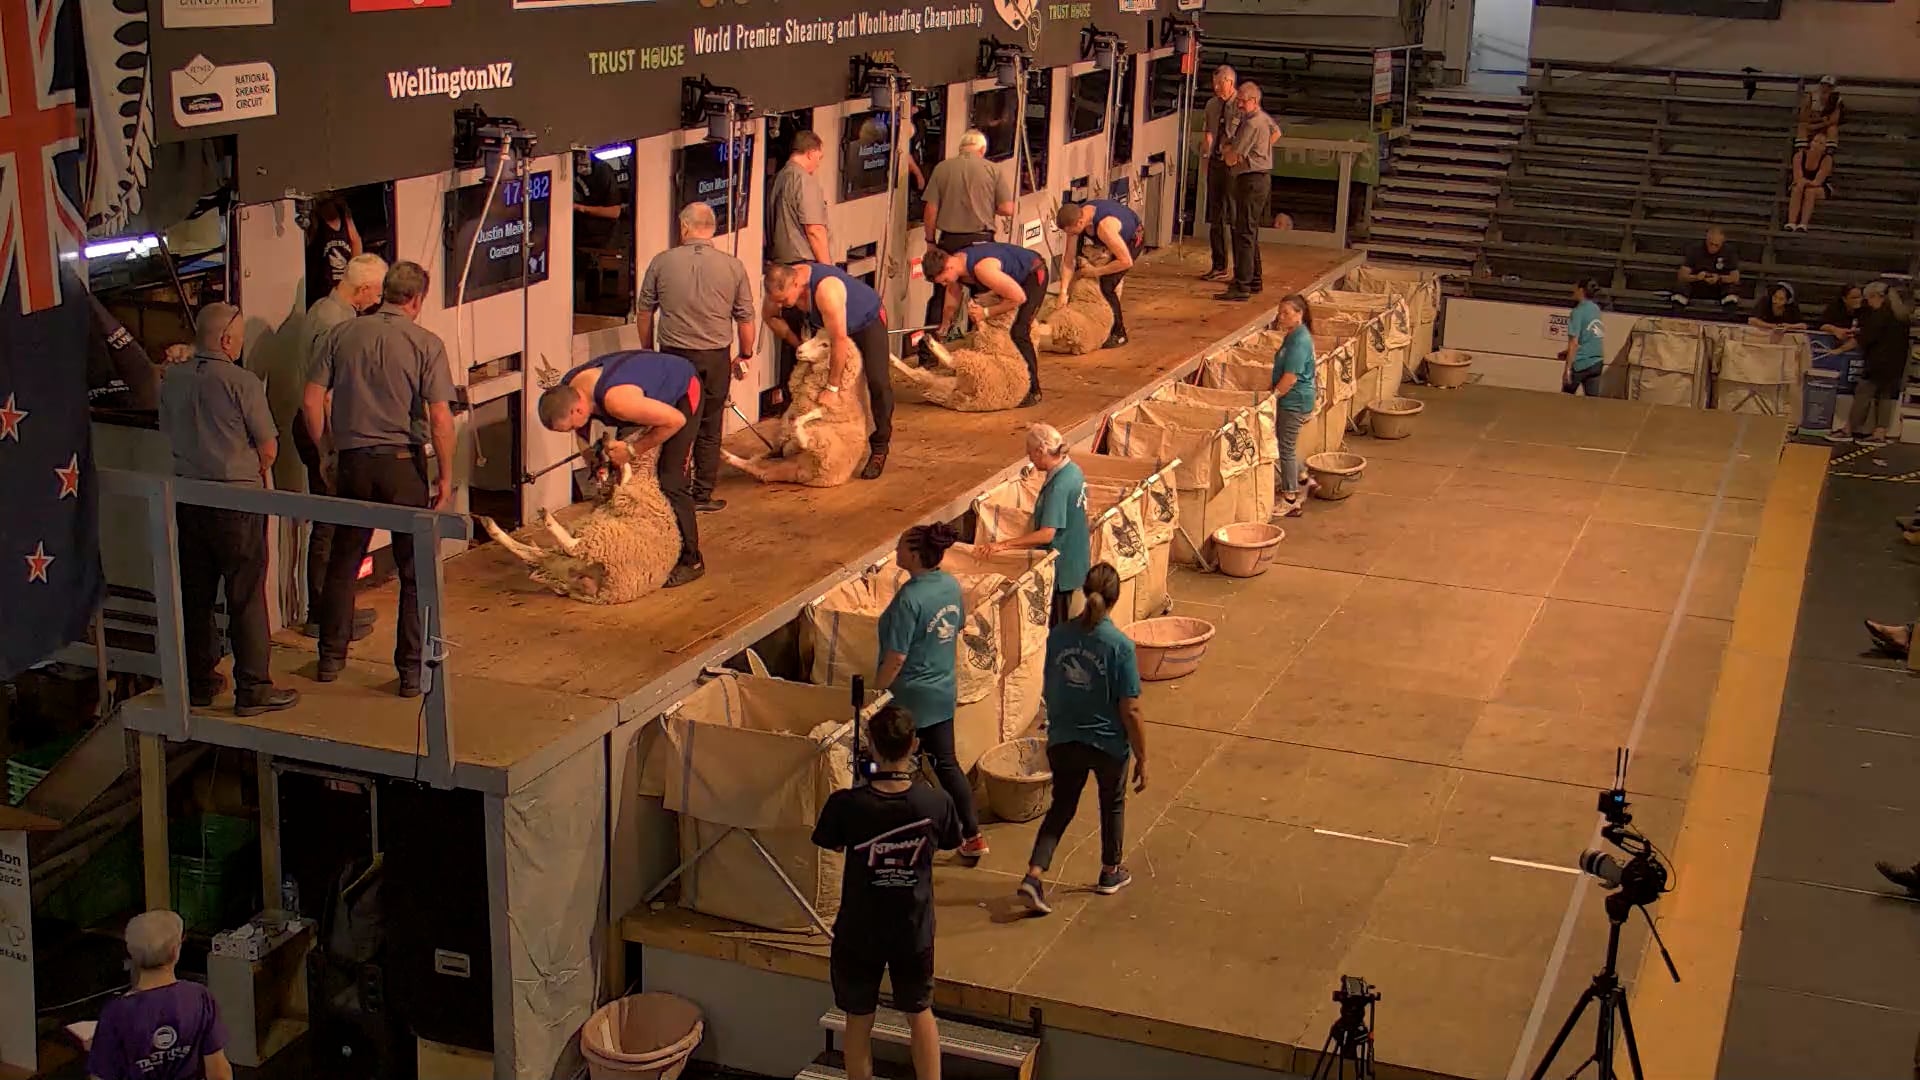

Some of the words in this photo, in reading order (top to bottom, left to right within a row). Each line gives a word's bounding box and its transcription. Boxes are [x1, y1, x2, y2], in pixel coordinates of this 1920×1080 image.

[1048, 4, 1068, 20] TRUST
[694, 25, 731, 55] World
[736, 22, 781, 50] Premier
[785, 18, 834, 45] Shearing
[837, 13, 855, 38] and
[858, 8, 921, 33] Woolhandling
[924, 3, 983, 31] Championship
[589, 49, 635, 75] TRUST
[640, 44, 685, 70] HOUSE
[235, 72, 270, 84] NATIONAL
[388, 62, 513, 99] WellingtonNZ
[235, 84, 270, 97] SHEARING
[236, 97, 263, 110] CIRCUIT
[477, 225, 504, 243] Justin
[505, 220, 533, 237] Meike
[489, 243, 520, 260] Oamaru
